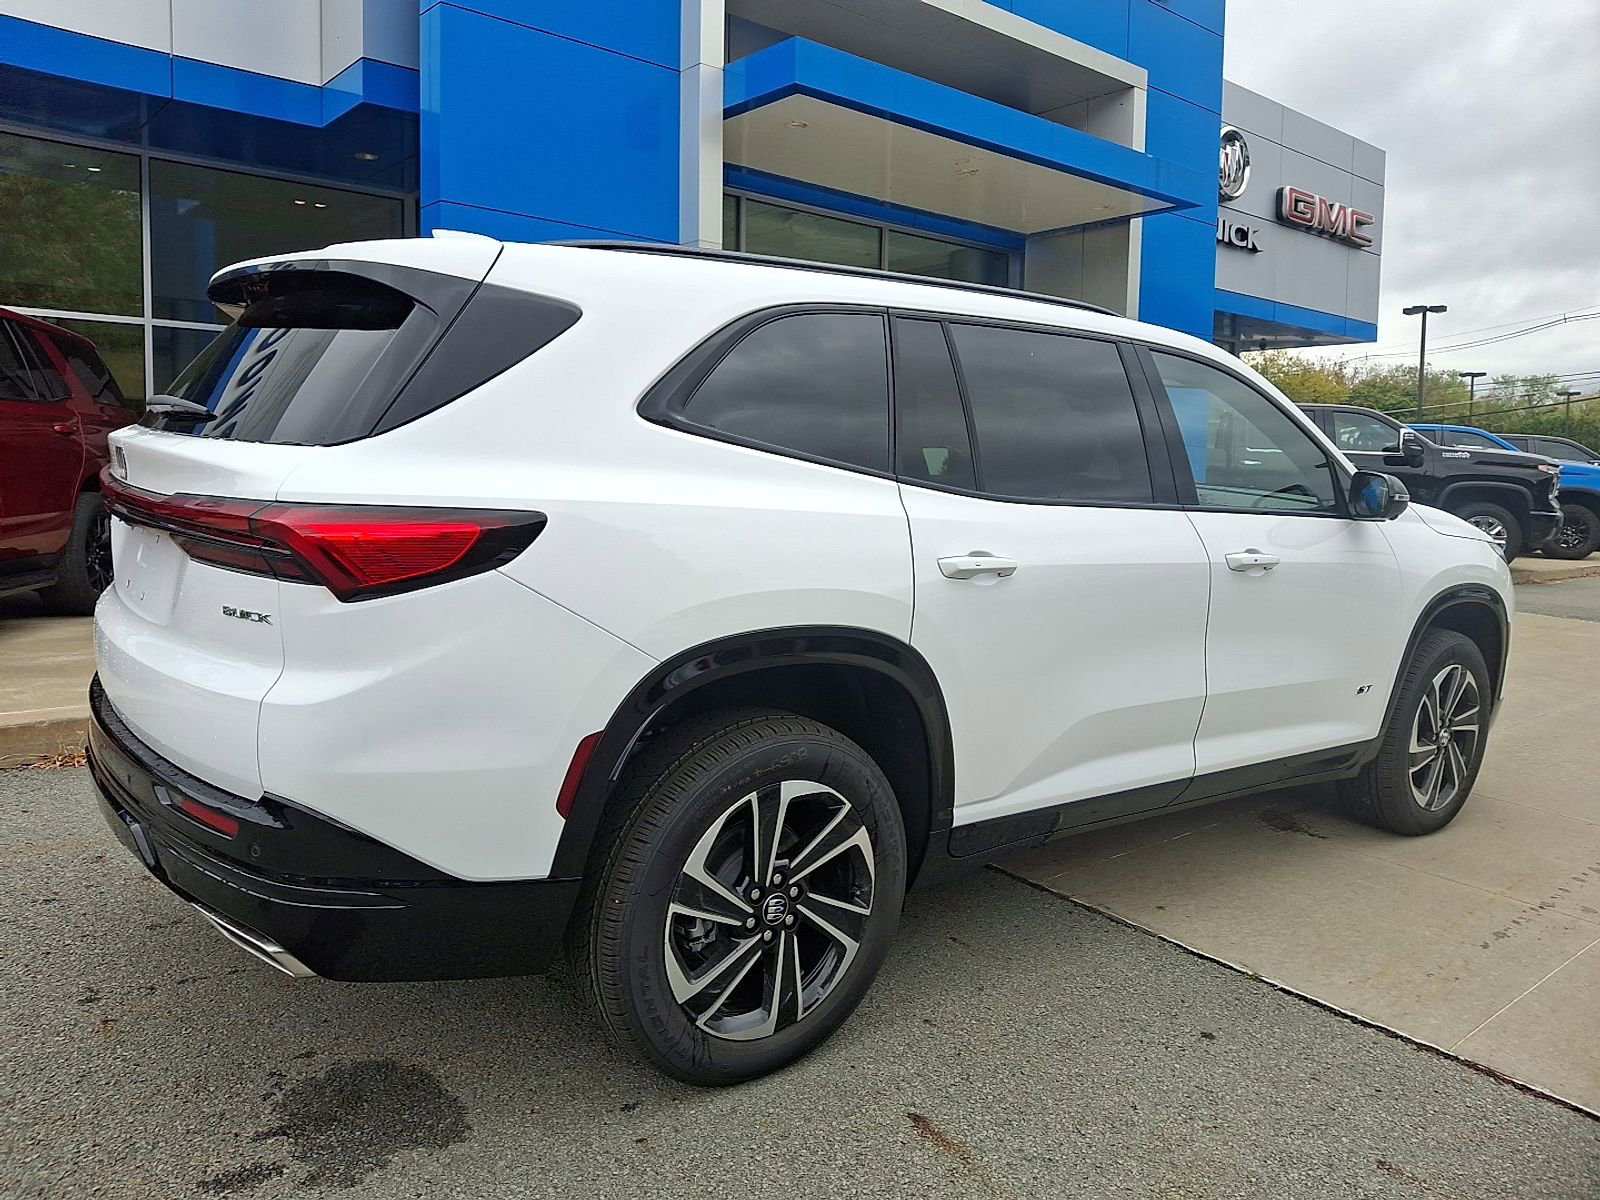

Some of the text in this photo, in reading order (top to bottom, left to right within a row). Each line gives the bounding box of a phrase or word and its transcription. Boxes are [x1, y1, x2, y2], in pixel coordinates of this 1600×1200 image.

[1278, 186, 1374, 247] GMC
[1217, 218, 1264, 252] ICK
[222, 605, 274, 627] BUICK
[1356, 684, 1374, 695] ST
